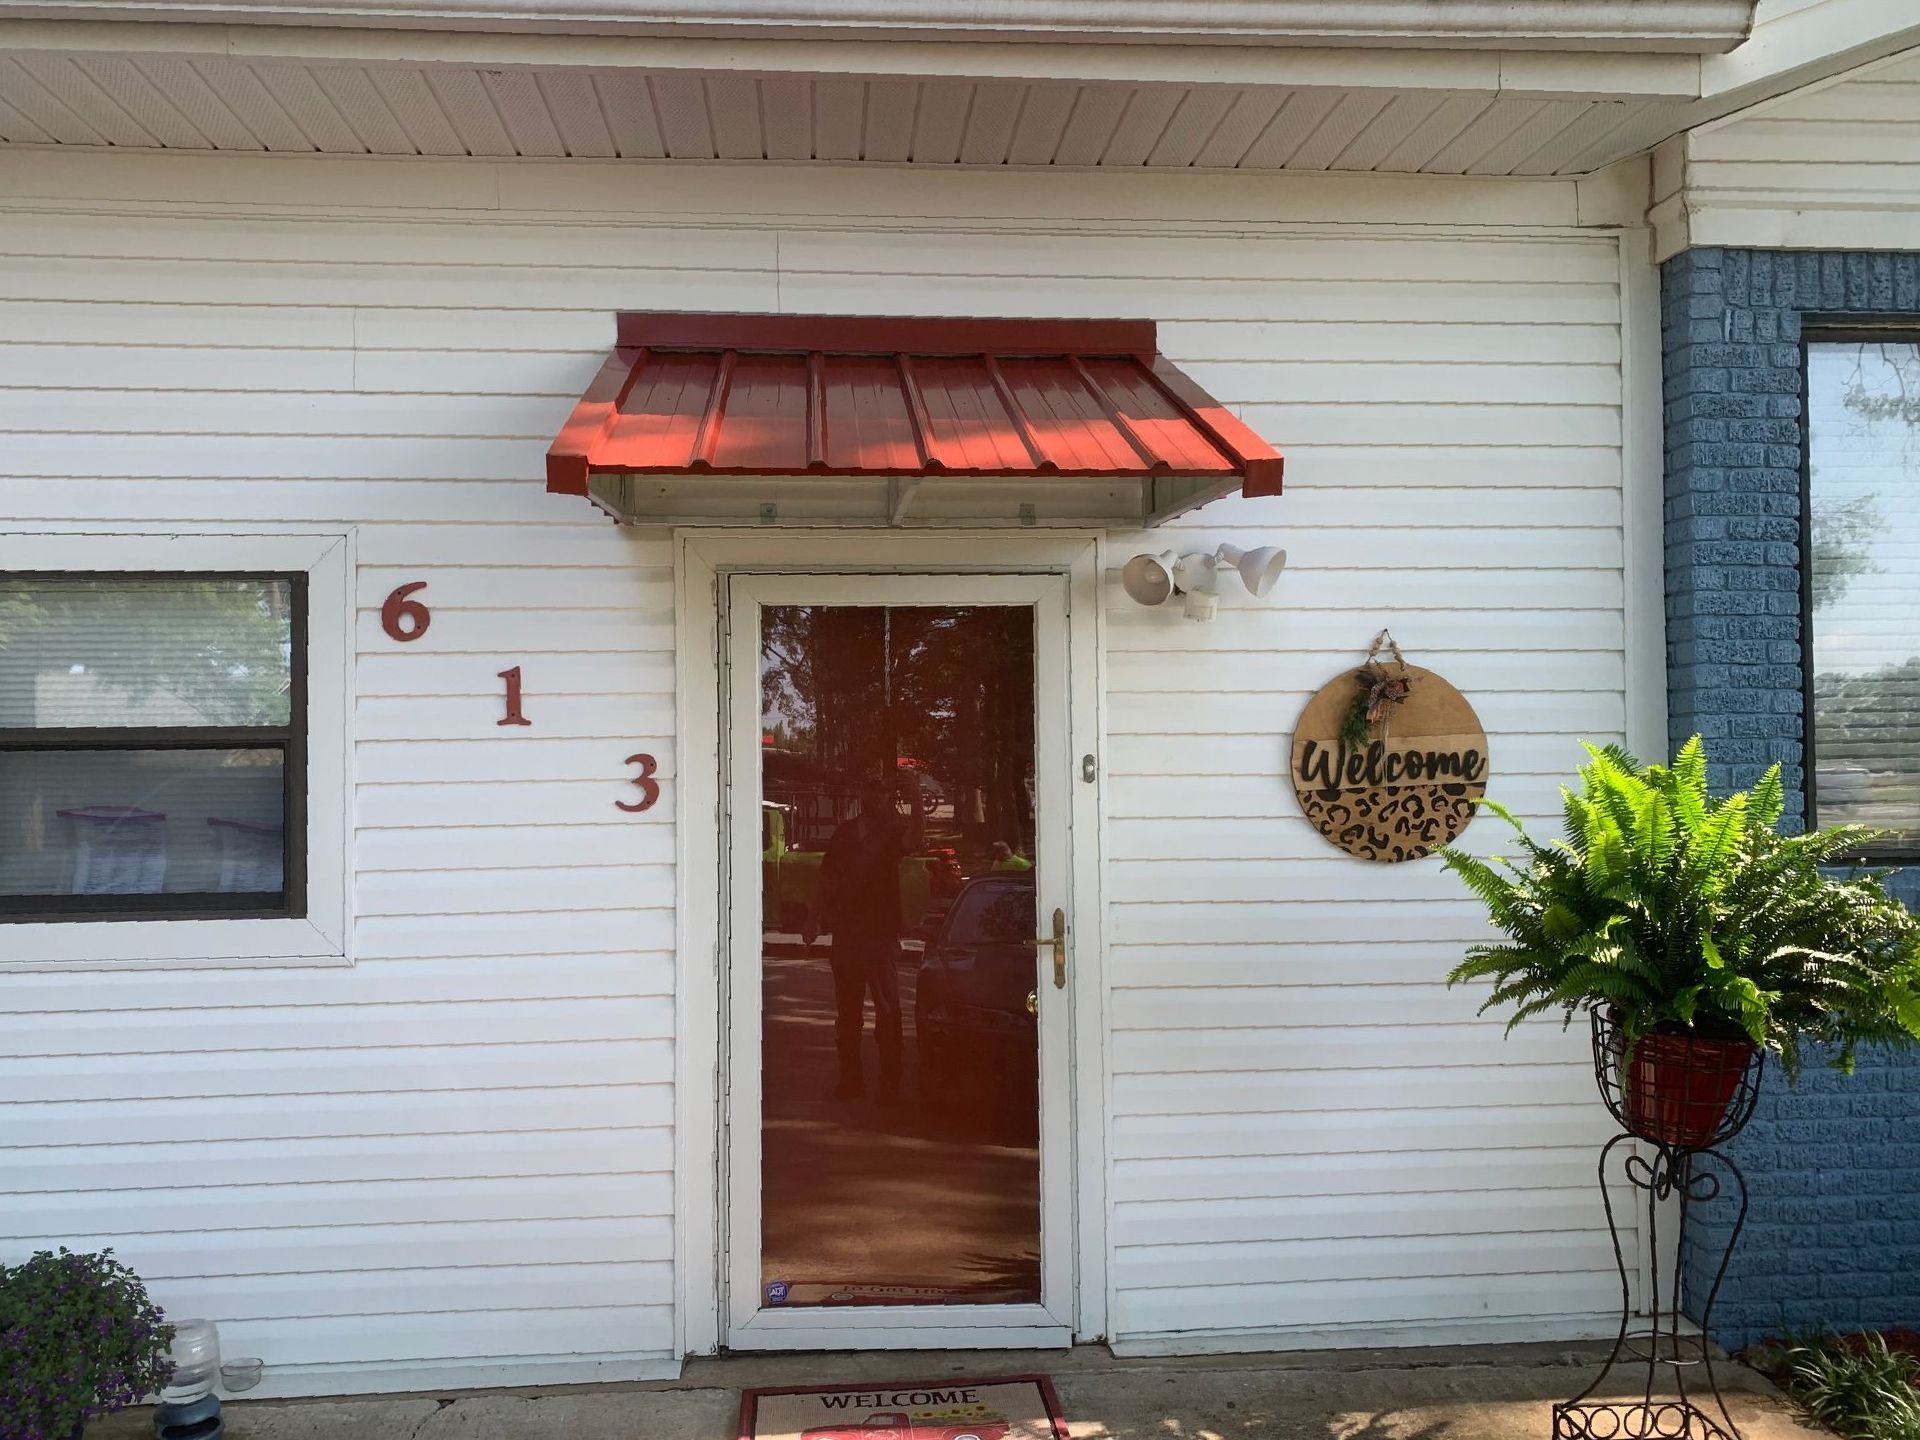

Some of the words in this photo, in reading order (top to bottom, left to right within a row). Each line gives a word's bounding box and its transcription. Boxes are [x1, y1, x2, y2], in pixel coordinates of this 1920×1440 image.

[381, 581, 431, 642] 6
[497, 665, 532, 726] 1
[614, 753, 660, 812] 3
[1300, 740, 1487, 789] Welcome
[820, 1389, 981, 1409] WELCOME
